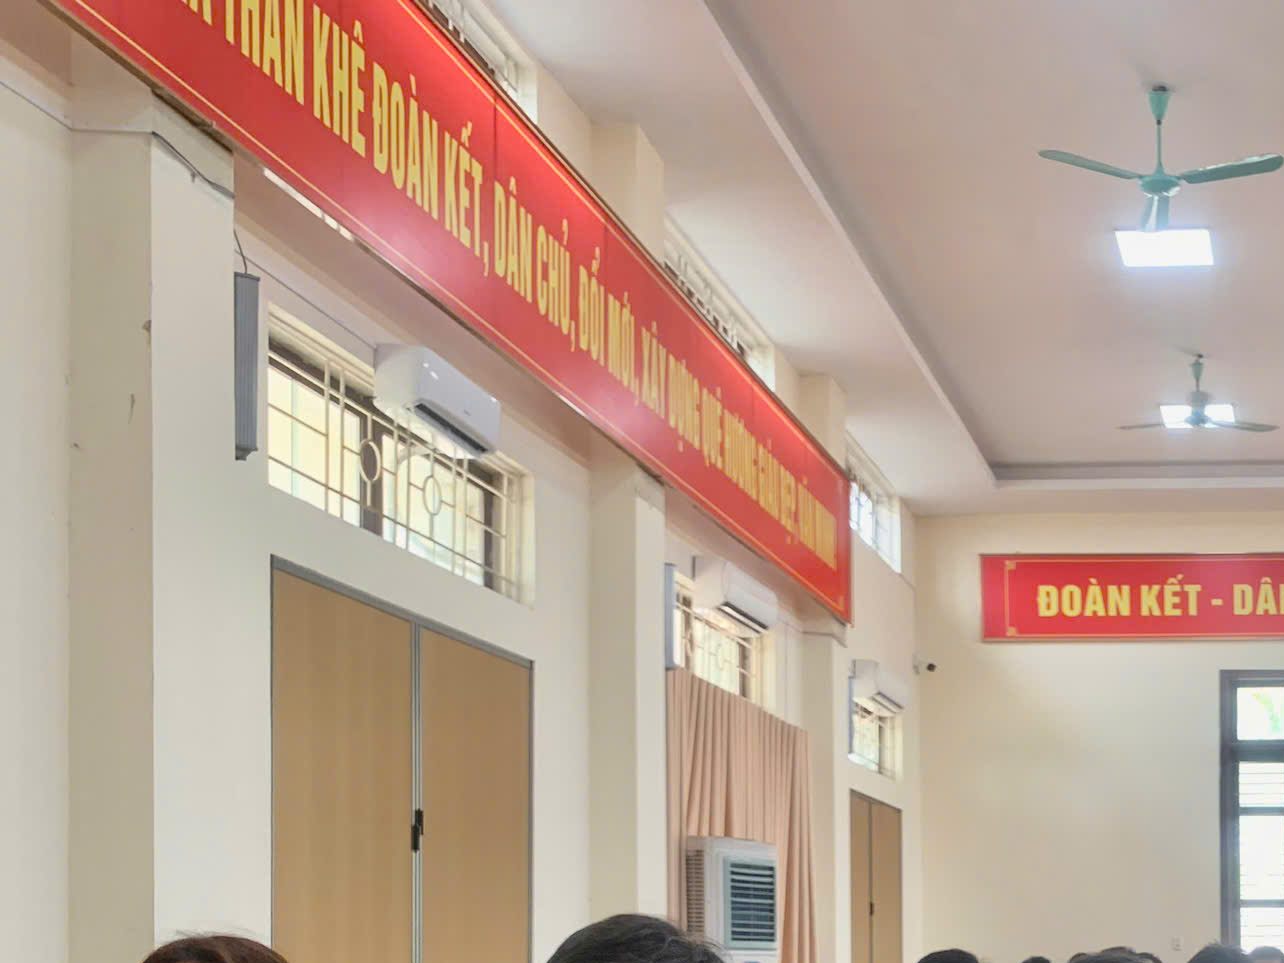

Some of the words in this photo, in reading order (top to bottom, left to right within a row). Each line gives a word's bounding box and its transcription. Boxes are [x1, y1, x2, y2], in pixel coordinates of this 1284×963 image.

[313, 3, 366, 158] KHÊ
[372, 61, 439, 221] ĐOÀN
[444, 121, 489, 278] KẾT,
[494, 176, 533, 304] DÂN
[1037, 577, 1130, 617] ĐOÀN
[1141, 573, 1203, 617] KẾT
